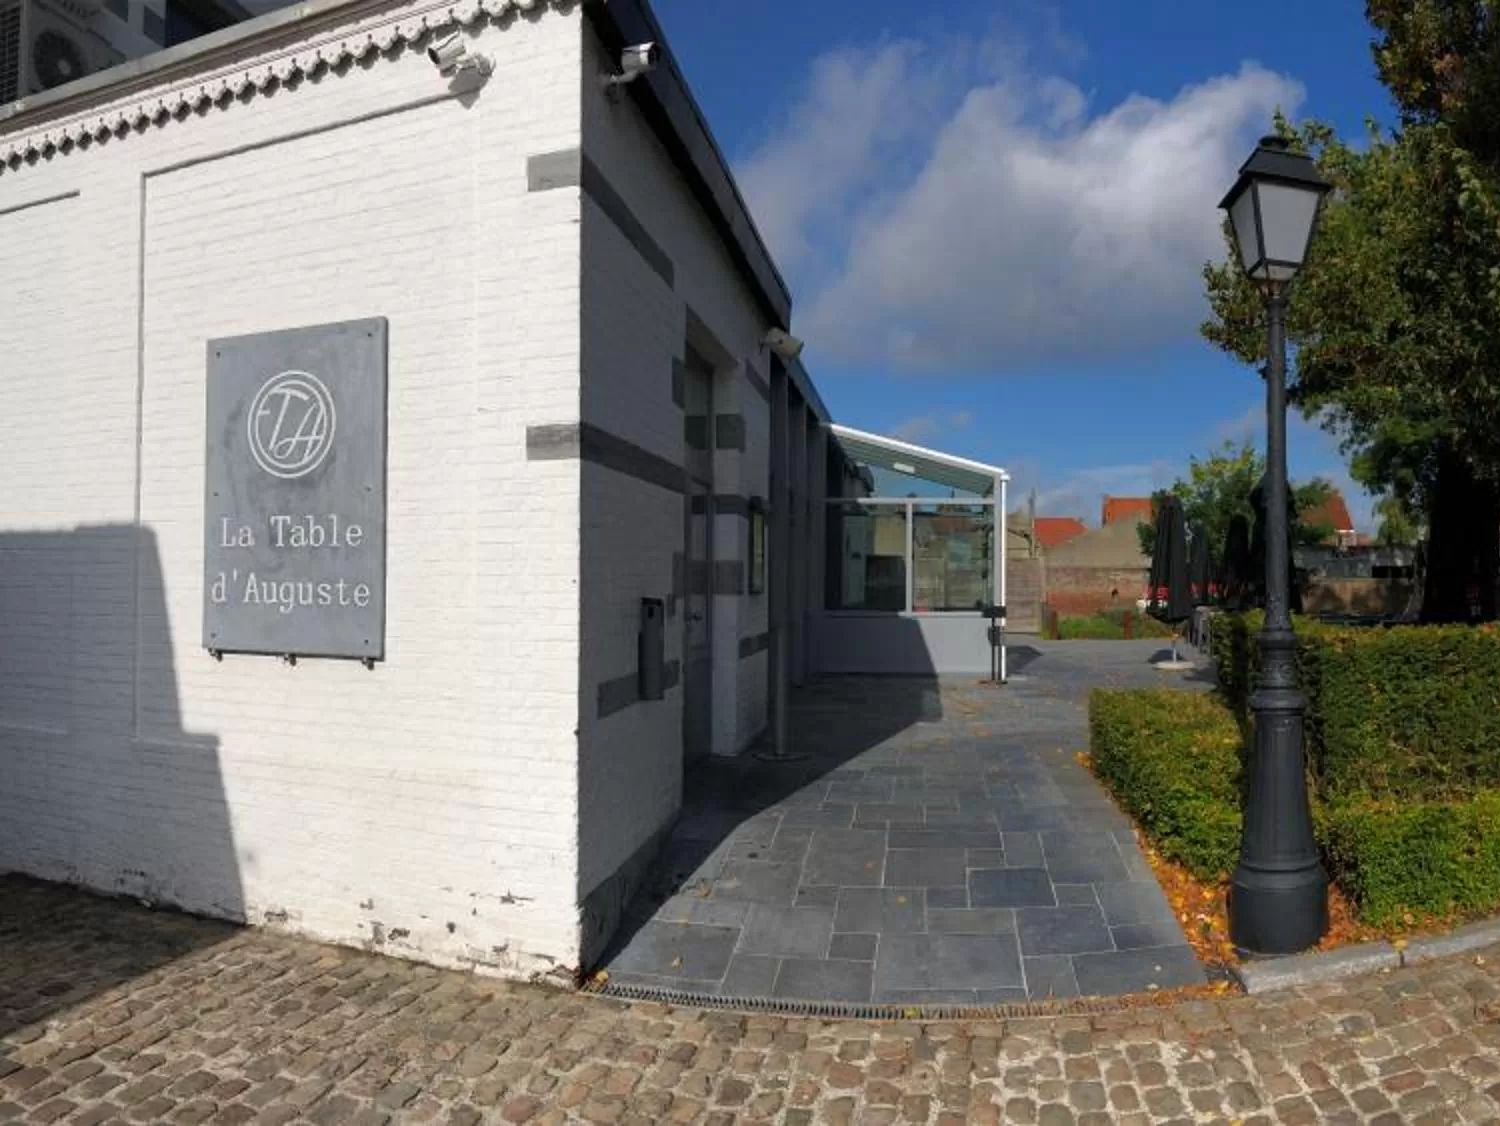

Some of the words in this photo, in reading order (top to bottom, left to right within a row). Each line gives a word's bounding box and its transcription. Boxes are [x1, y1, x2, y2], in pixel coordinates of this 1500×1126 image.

[219, 517, 256, 548] La
[269, 514, 364, 548] Table
[210, 568, 371, 615] d'Auguste
